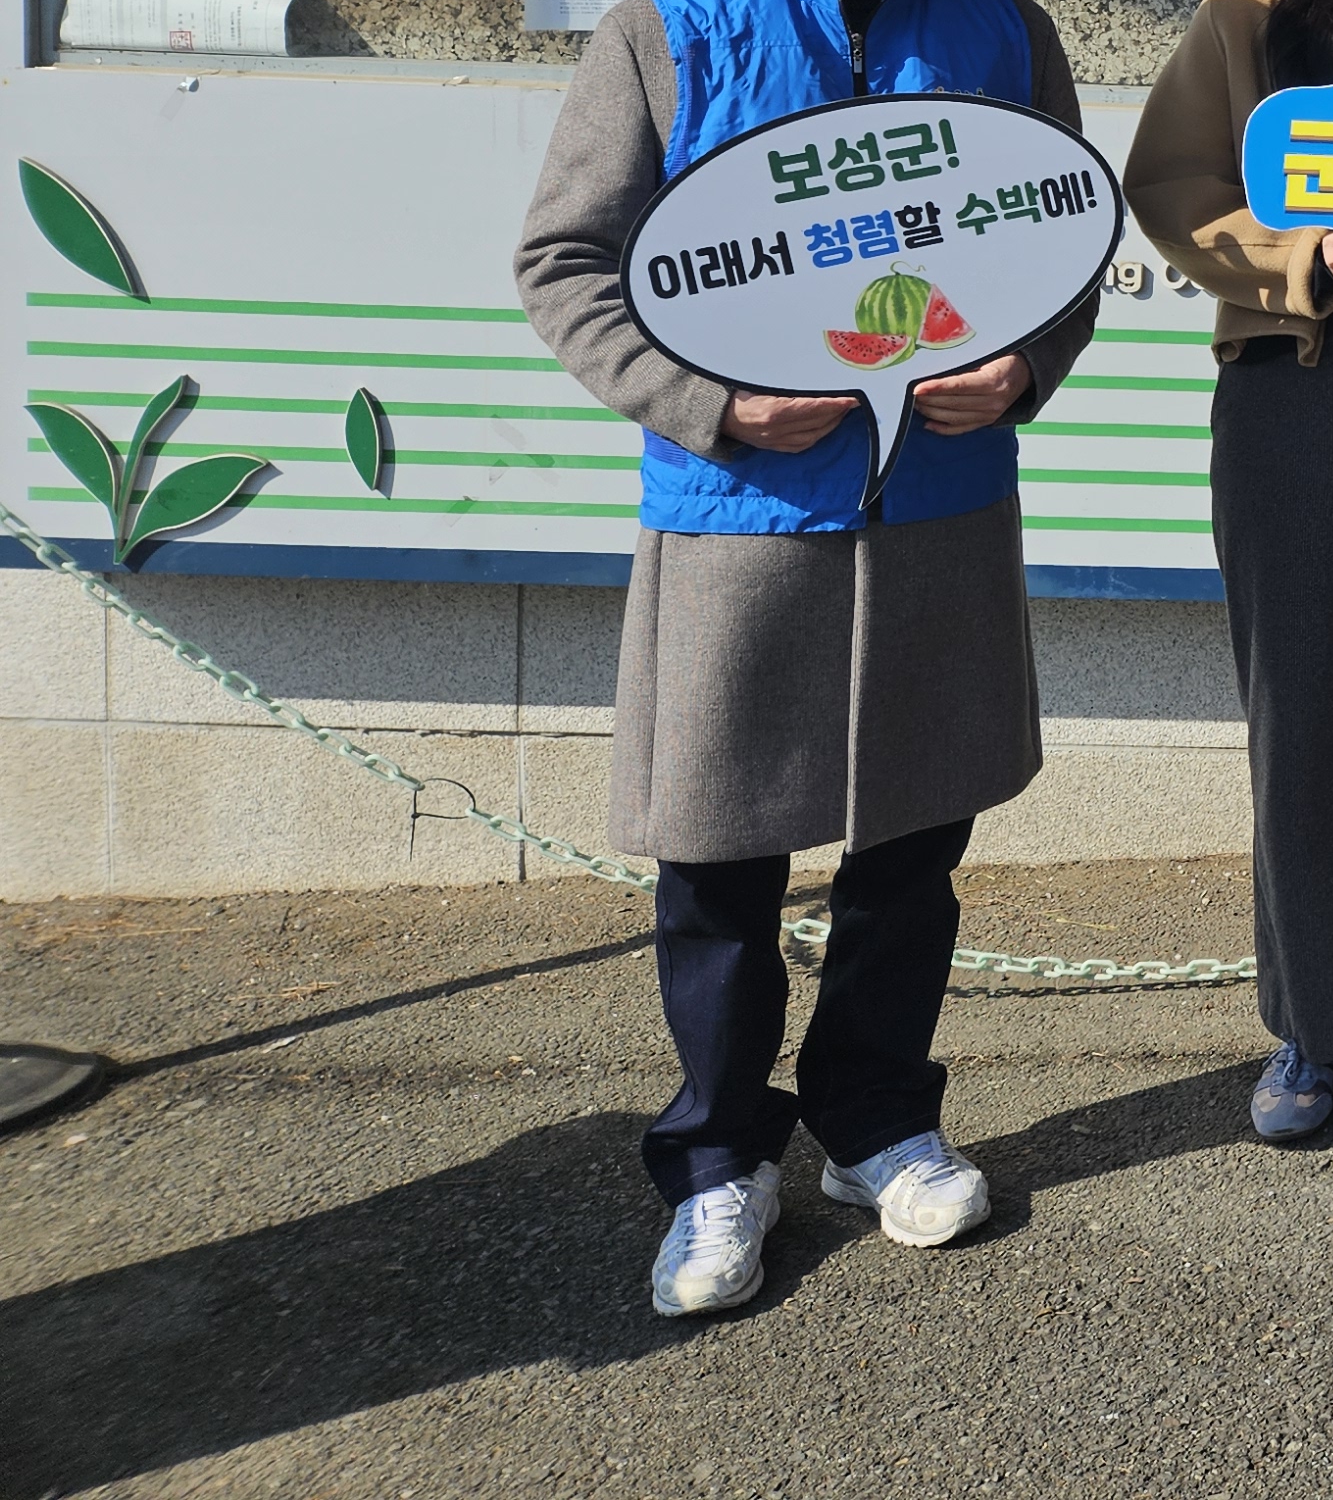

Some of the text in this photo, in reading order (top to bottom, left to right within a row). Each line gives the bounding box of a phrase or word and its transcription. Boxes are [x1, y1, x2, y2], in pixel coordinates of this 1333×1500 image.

[767, 117, 961, 205] 보성군!
[648, 170, 1099, 299] 이래서 청렴할 수박에!
